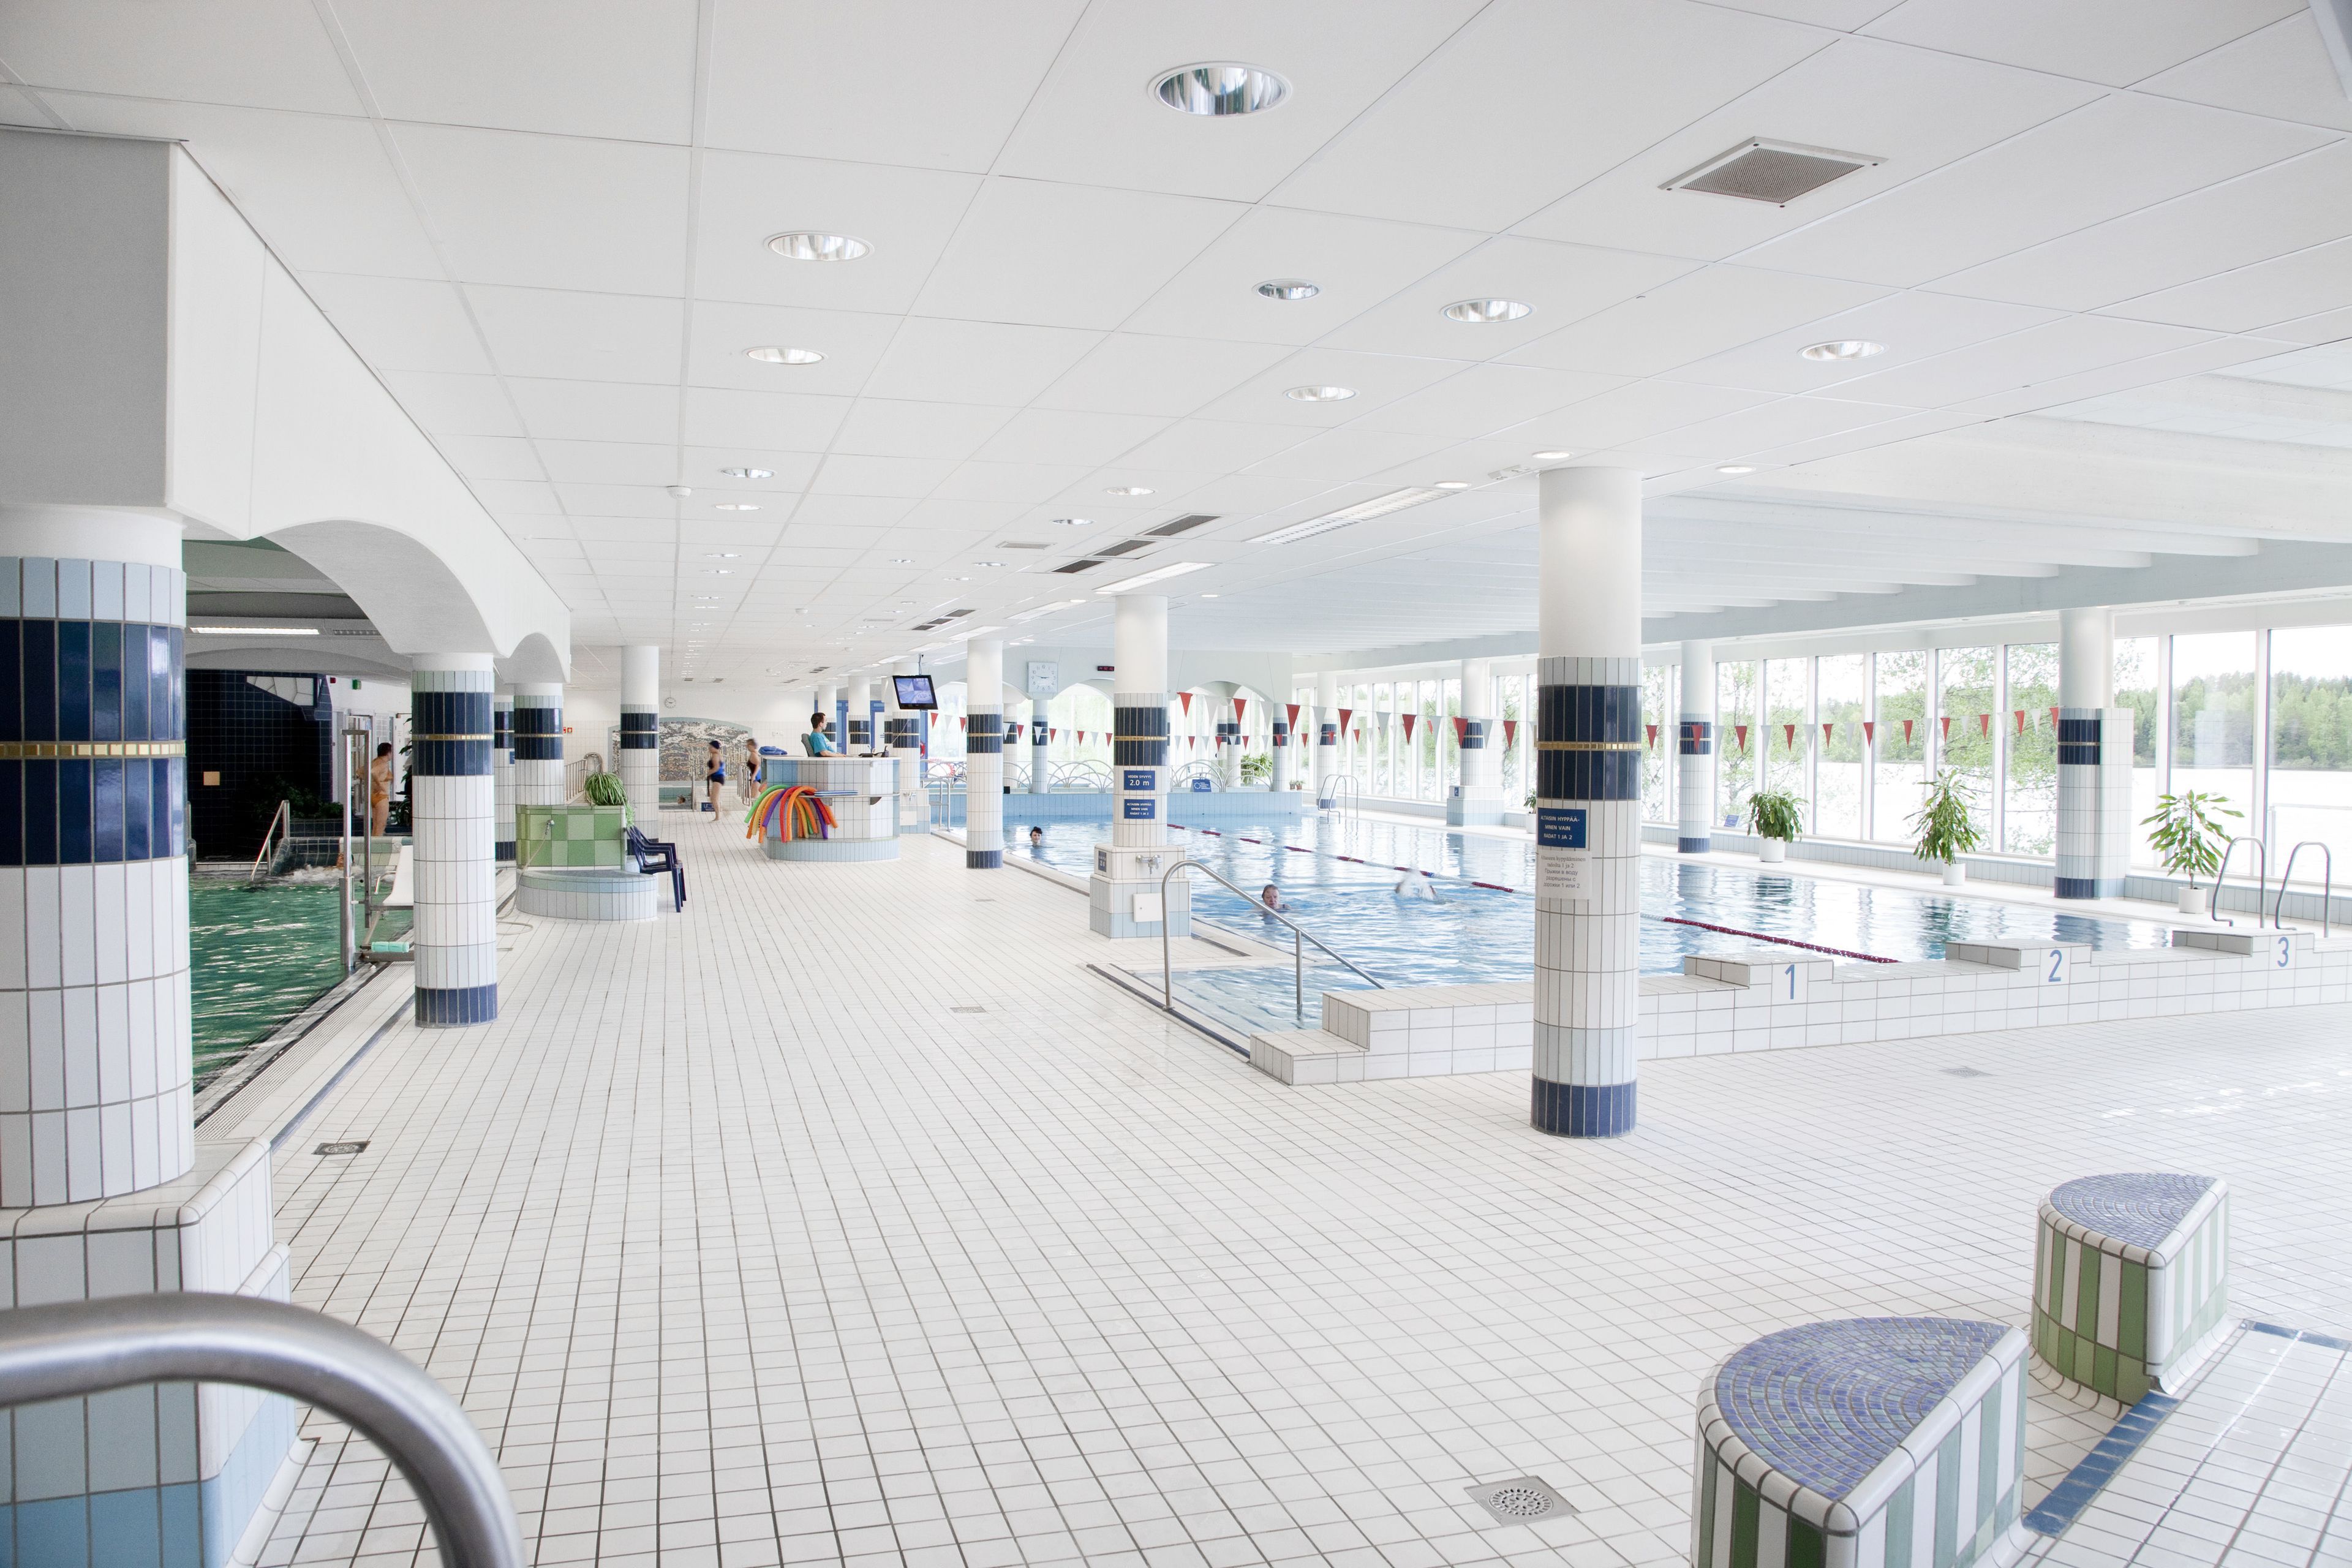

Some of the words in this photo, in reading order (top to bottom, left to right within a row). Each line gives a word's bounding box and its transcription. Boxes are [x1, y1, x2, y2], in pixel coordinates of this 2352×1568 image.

[2048, 949, 2062, 982] 2
[2277, 937, 2289, 967] 3
[1785, 964, 1795, 1000] 1
